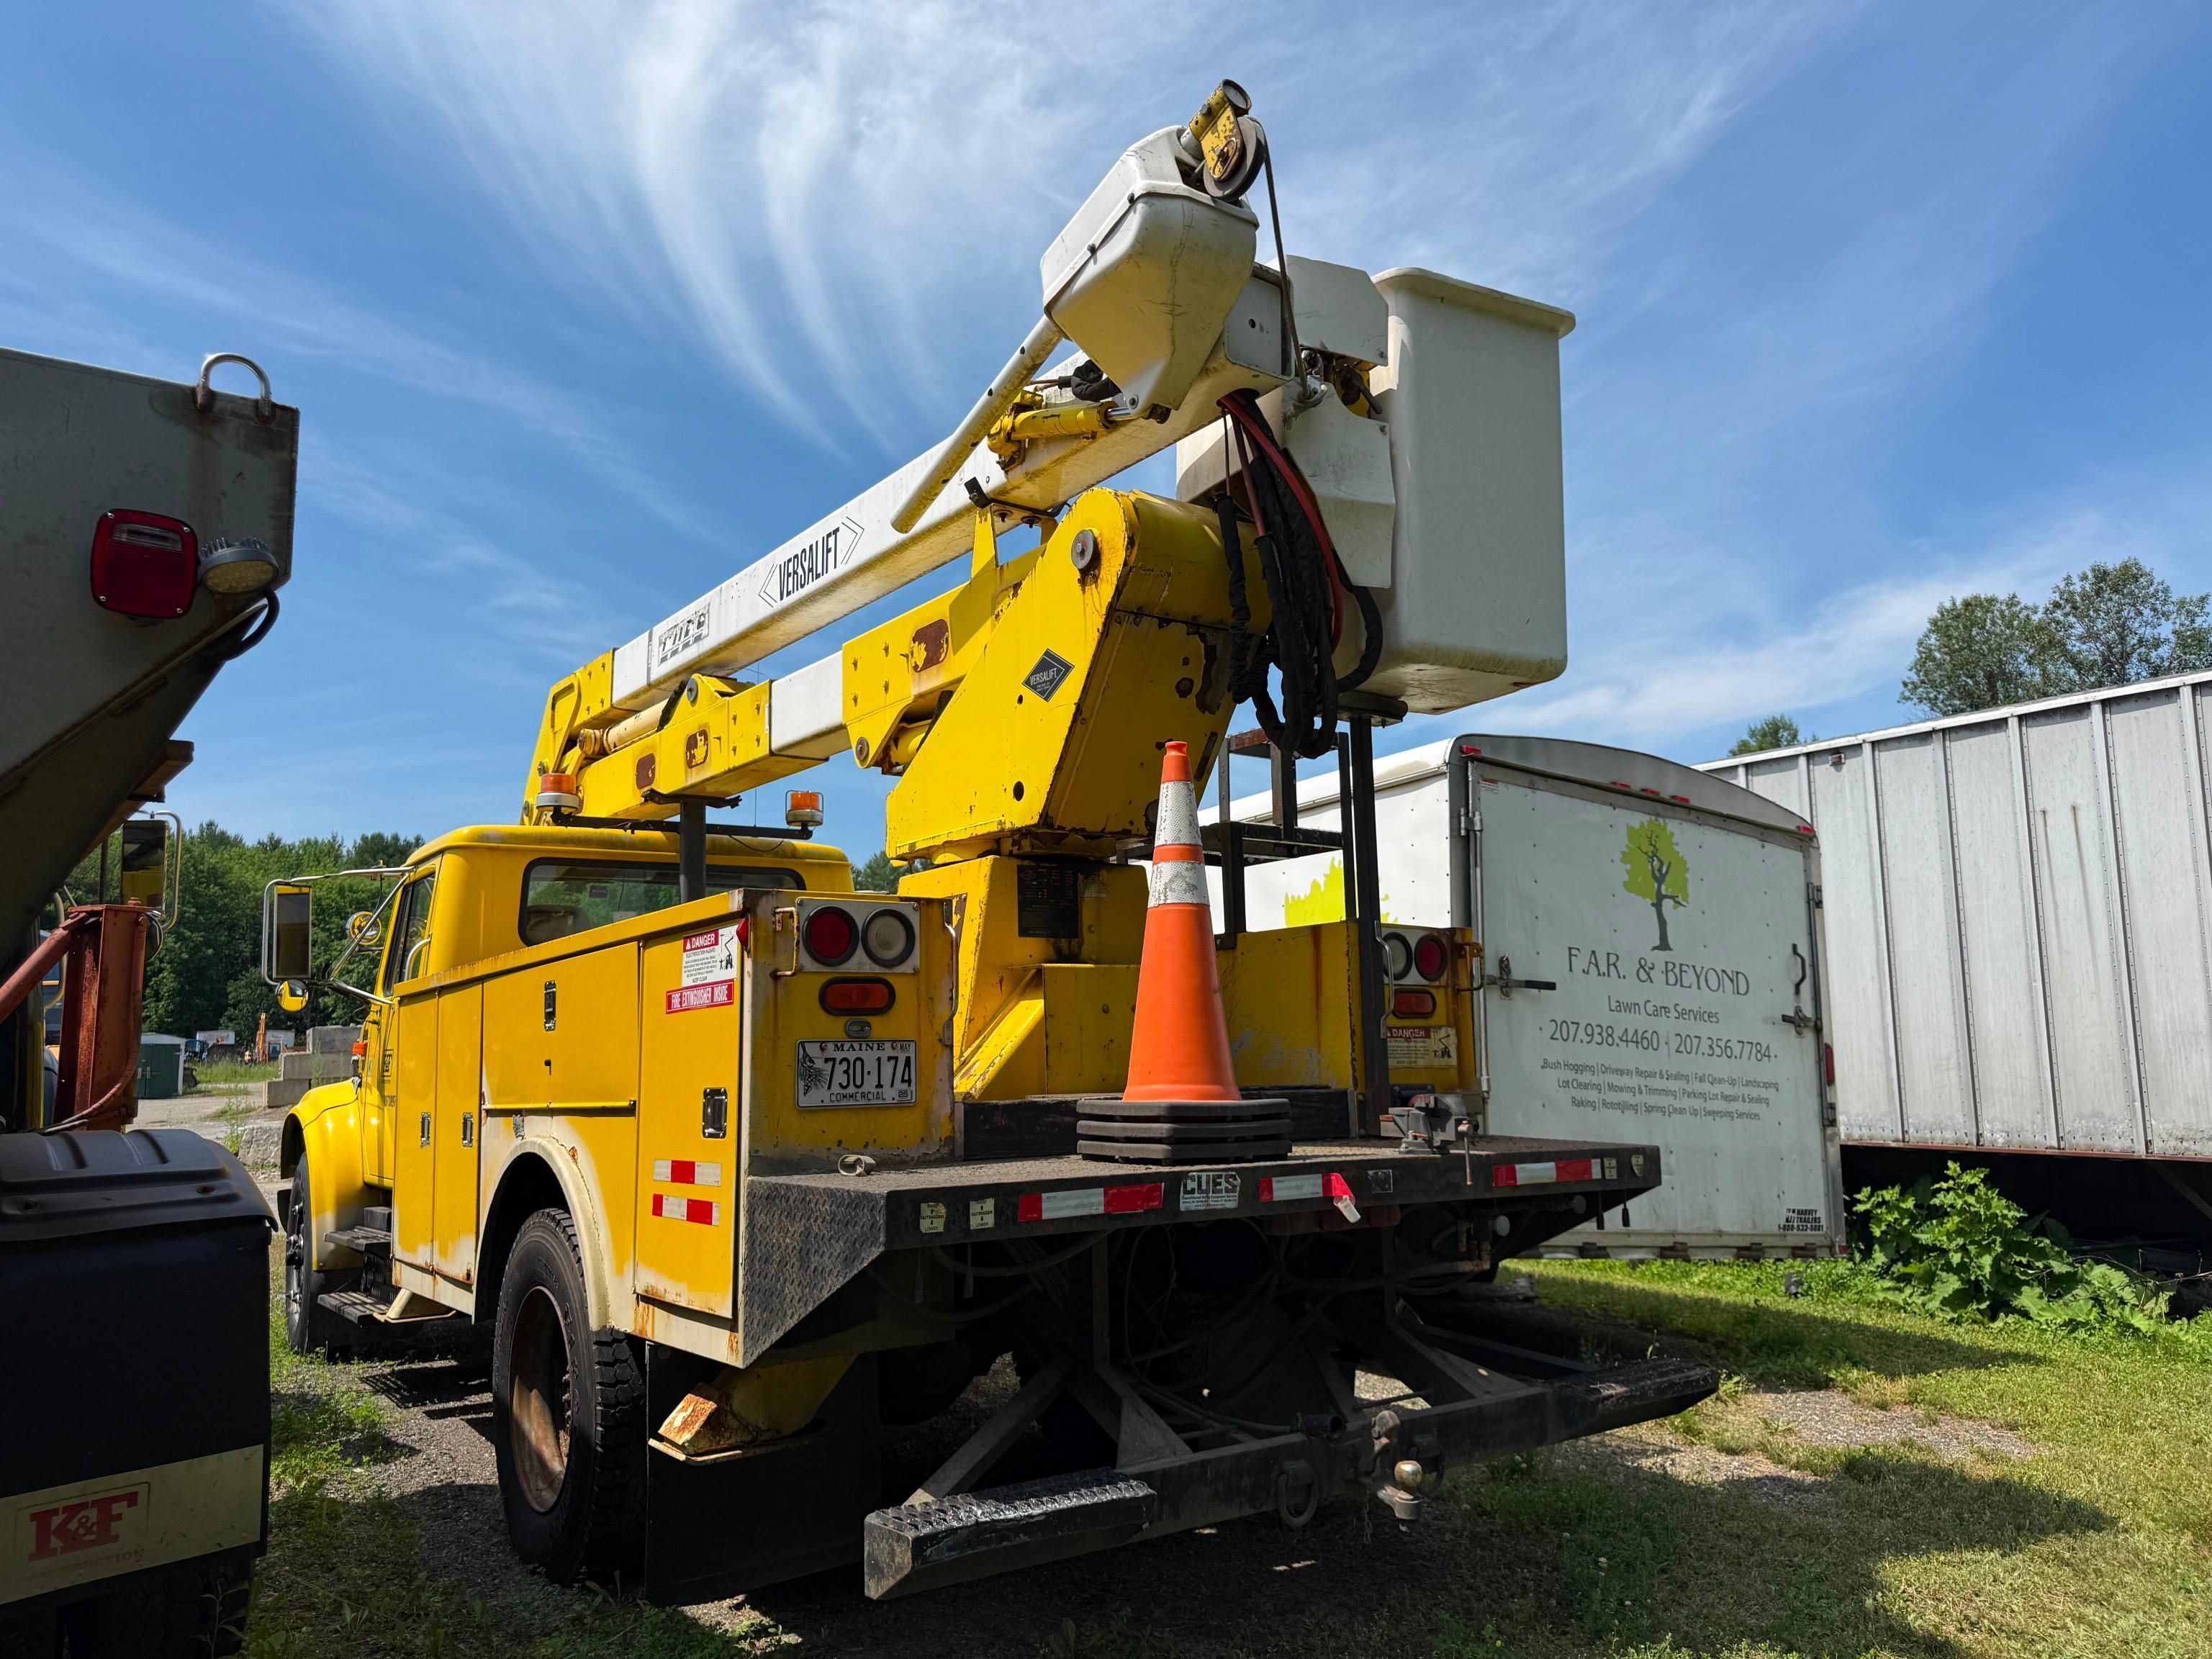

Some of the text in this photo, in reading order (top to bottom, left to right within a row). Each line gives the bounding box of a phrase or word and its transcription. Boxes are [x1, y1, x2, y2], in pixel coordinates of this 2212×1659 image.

[779, 526, 840, 601] VERSALIFT
[1029, 667, 1057, 686] VERSALIFT
[691, 933, 715, 949] DANGER
[1568, 946, 1750, 996] F.A.R. & BEYOND
[671, 985, 728, 1009] FIRE EXTINGUISHER INSIDE
[1607, 995, 1720, 1025] Lawn Care Services
[1391, 1029, 1425, 1038] DANGER
[1548, 1018, 1661, 1052] 207.938.4460
[1674, 1033, 1772, 1063] 207.356.7784
[832, 1042, 911, 1052] MAINE MAY
[1543, 1058, 1562, 1070] Bush
[1563, 1059, 1595, 1076] Hogging
[1600, 1063, 1634, 1079] Driveway
[1635, 1067, 1658, 1080] Repair
[1665, 1070, 1690, 1084] Sealing
[1694, 1072, 1707, 1083] Fall
[1707, 1073, 1738, 1087] Clean-Up
[1741, 1077, 1780, 1092] Landscaping
[829, 1090, 886, 1103] COMMERCIAL
[1557, 1077, 1570, 1089] Lot
[1571, 1078, 1602, 1094] Clearing
[1607, 1082, 1637, 1096] Mowing
[1643, 1085, 1677, 1100] Trimming
[1681, 1088, 1707, 1102] Parking
[1708, 1090, 1720, 1101] Lot
[1720, 1091, 1741, 1104] Repair
[1747, 1093, 1770, 1108] Sealing
[1571, 1095, 1597, 1111] Raking
[1601, 1098, 1639, 1115] Rototilling
[1643, 1101, 1666, 1117] Spring
[1667, 1103, 1687, 1116] Clean
[1688, 1105, 1699, 1118] Up
[1702, 1106, 1735, 1121] Sweeping
[1735, 1108, 1761, 1121] Services
[1182, 1174, 1238, 1195] CUES
[28, 1491, 139, 1563] K&F
